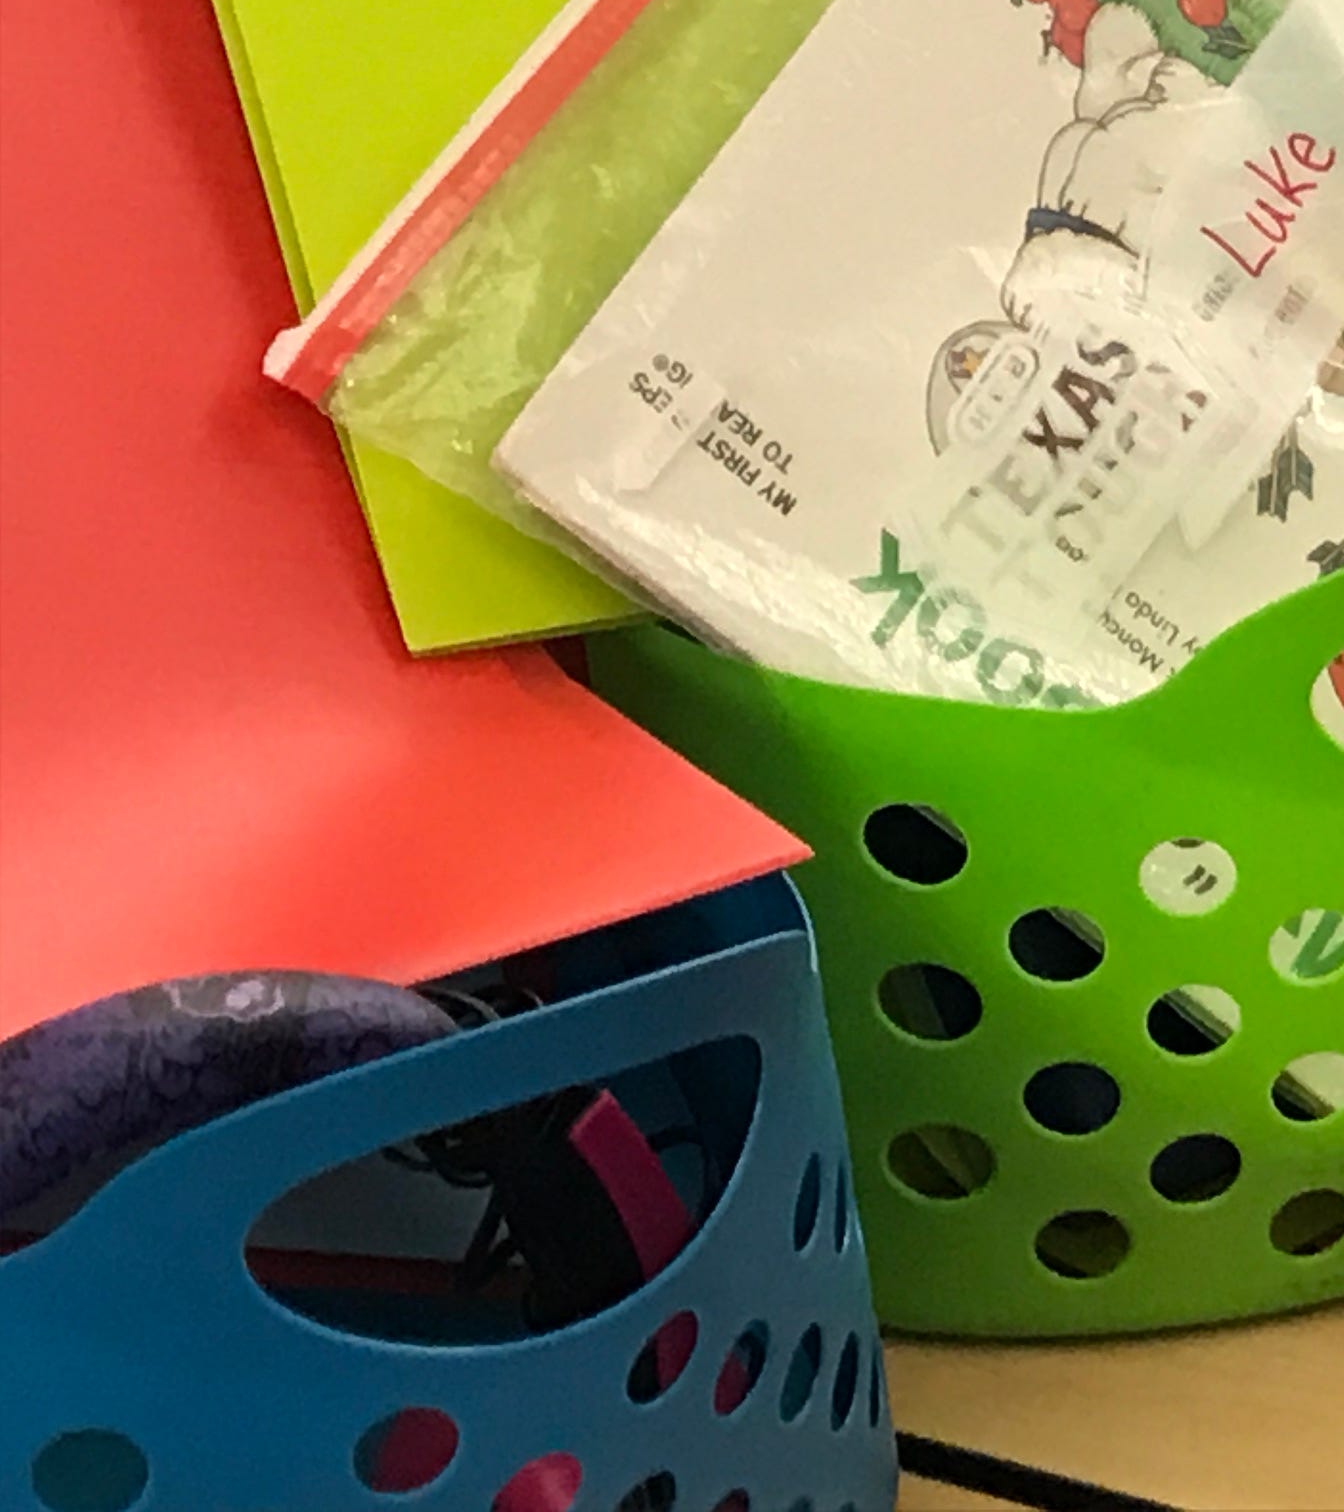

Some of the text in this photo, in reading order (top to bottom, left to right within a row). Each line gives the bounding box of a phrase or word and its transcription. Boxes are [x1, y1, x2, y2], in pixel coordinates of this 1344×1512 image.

[1200, 130, 1337, 279] Luke
[696, 430, 762, 487] FIRST
[762, 440, 793, 476] TO
[757, 480, 798, 517] MY
[848, 526, 1108, 710] ook
[1124, 591, 1180, 647] Linda
